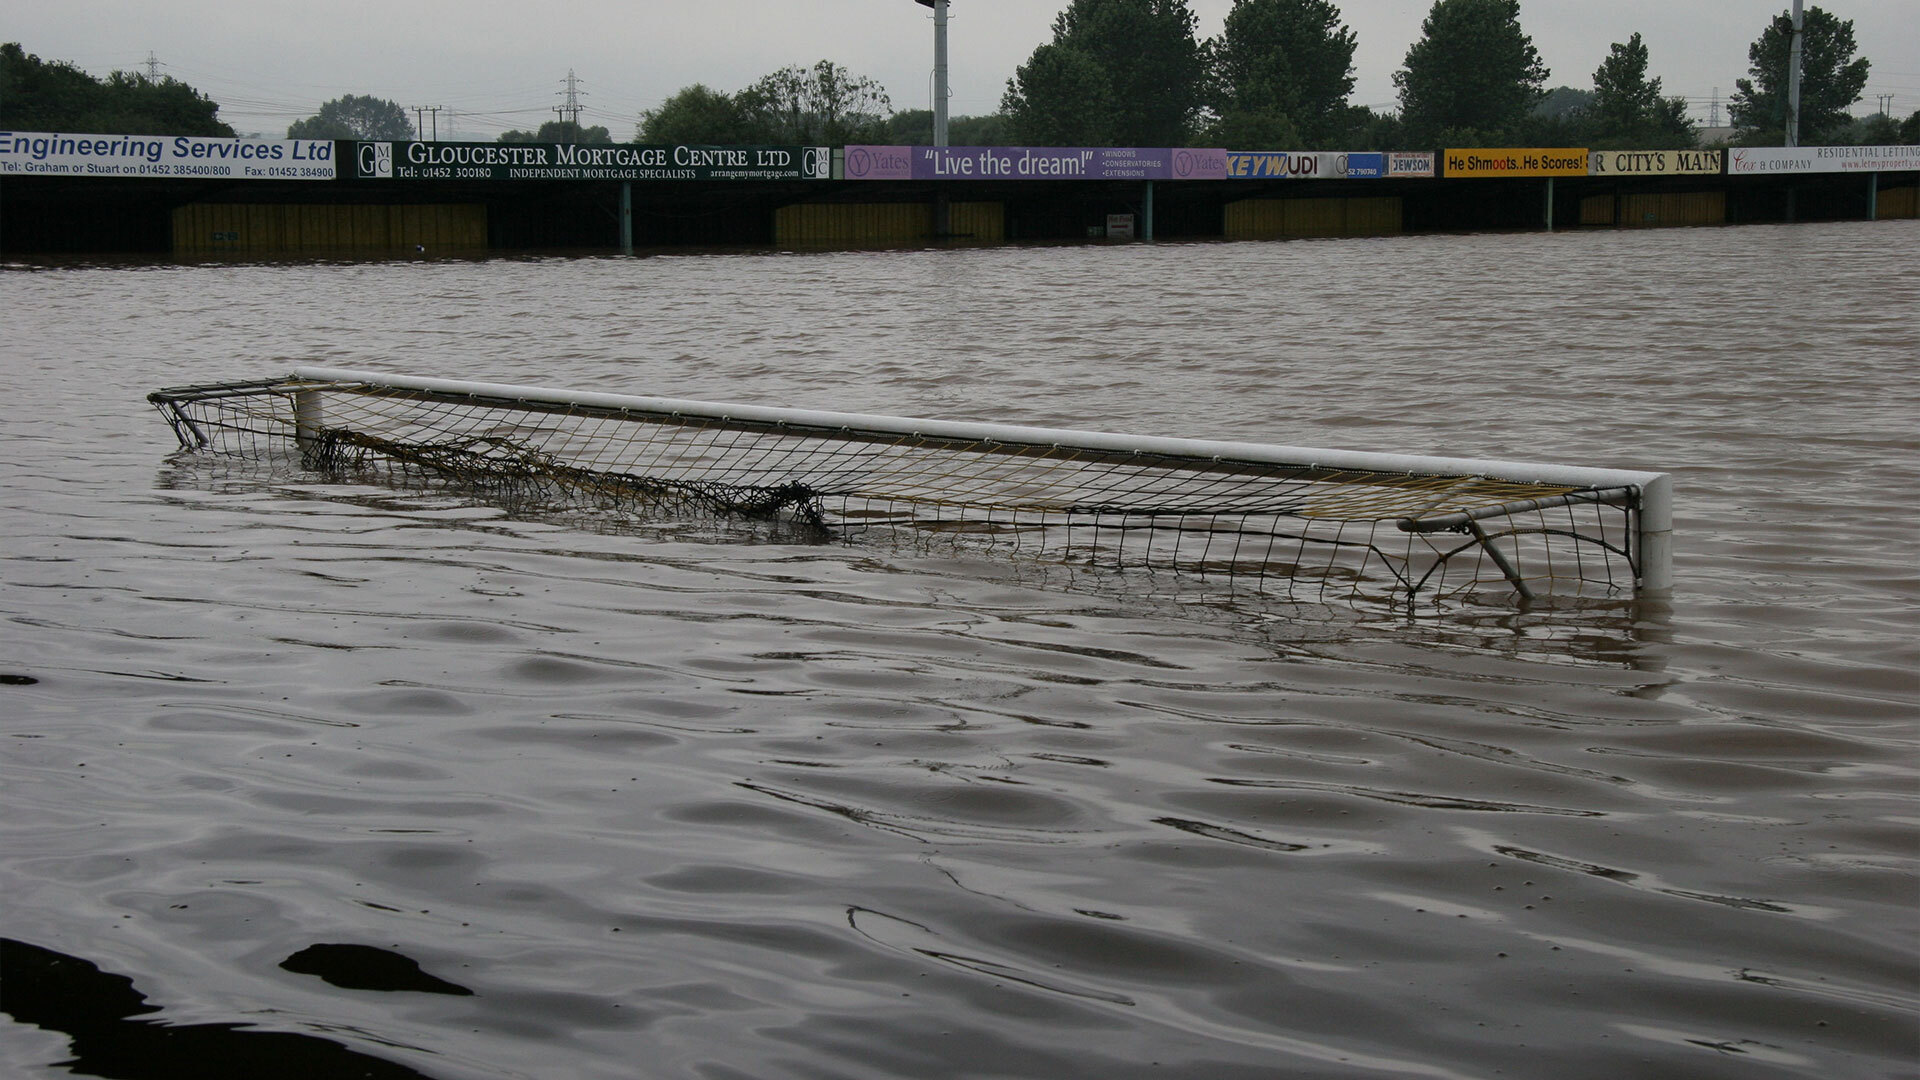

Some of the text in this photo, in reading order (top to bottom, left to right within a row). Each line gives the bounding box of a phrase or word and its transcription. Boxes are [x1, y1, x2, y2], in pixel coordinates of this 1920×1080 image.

[0, 133, 333, 162] Engineering Services Ltd
[407, 142, 791, 166] GLOUCESTER MORTGAGE CENTRE LTD
[1817, 147, 1879, 159] RESIDENTIAL
[872, 152, 909, 170] Yates
[979, 149, 1011, 175] the
[1193, 154, 1225, 170] Yates
[1393, 159, 1430, 171] JEWSON
[1449, 156, 1464, 170] He
[1541, 155, 1582, 170] Scores!
[1615, 152, 1665, 172] CITY'S
[1675, 153, 1720, 171] MAIN
[1759, 160, 1766, 170] &
[1769, 159, 1812, 170] COMPANY
[1, 161, 231, 176] Tel: Graham or Stuart on 01452 385400/800
[245, 167, 334, 177] Fax: 01452 384900
[398, 166, 492, 178] Tel: 01452 300180
[509, 168, 696, 179] INDEPENDENT MORTGAGE SPECIALISTS
[710, 169, 799, 180] arrangemymortgage.com
[1105, 169, 1145, 177] EXTENSIONS
